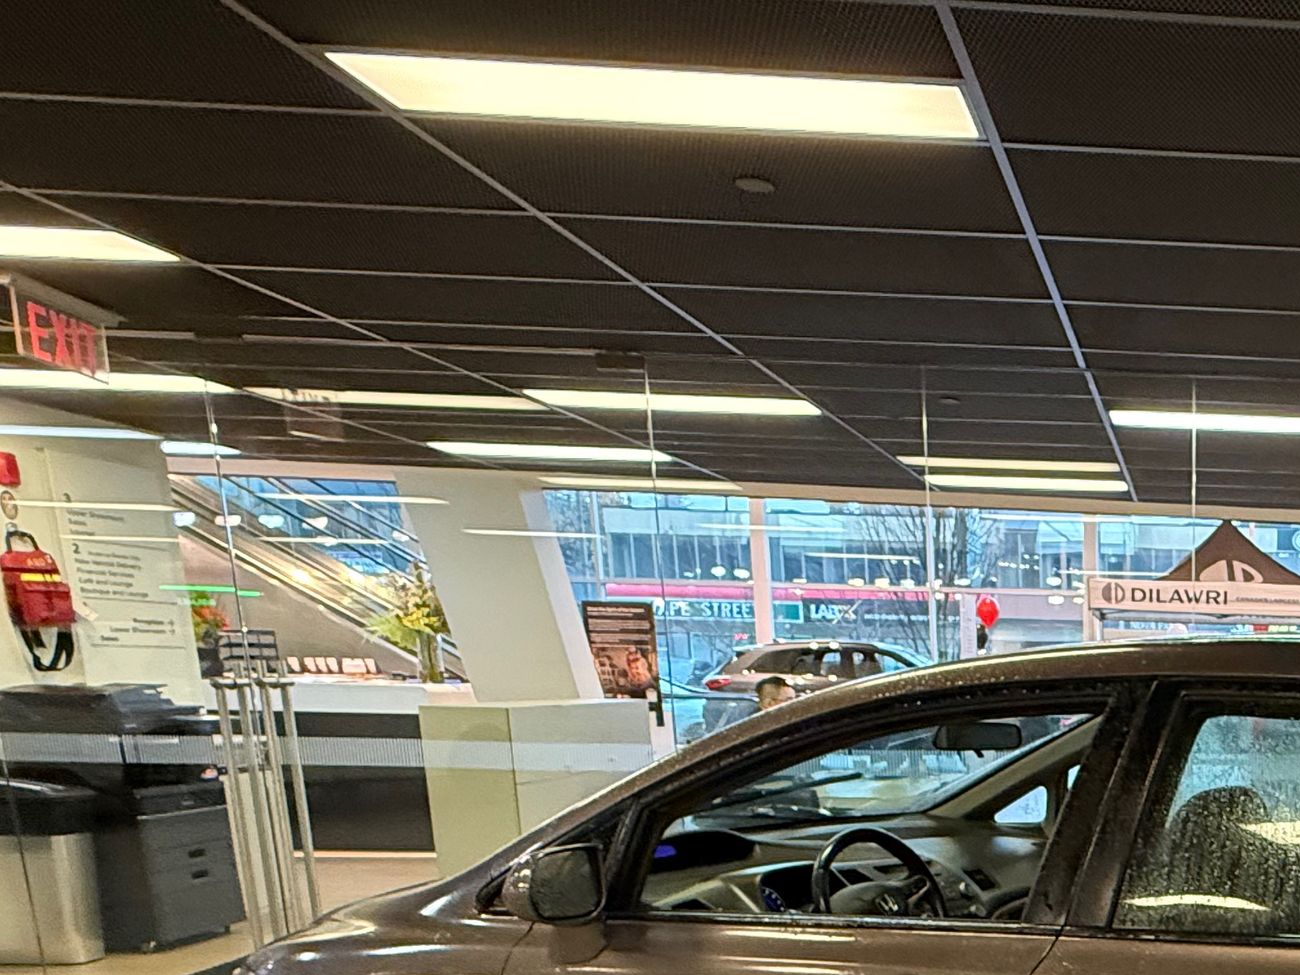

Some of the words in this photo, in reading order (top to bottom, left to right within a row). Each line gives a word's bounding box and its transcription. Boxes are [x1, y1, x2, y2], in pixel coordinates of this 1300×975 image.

[27, 301, 97, 377] EXIT
[72, 543, 81, 554] 2
[1131, 588, 1228, 605] DILAWRI
[701, 602, 754, 618] STREE
